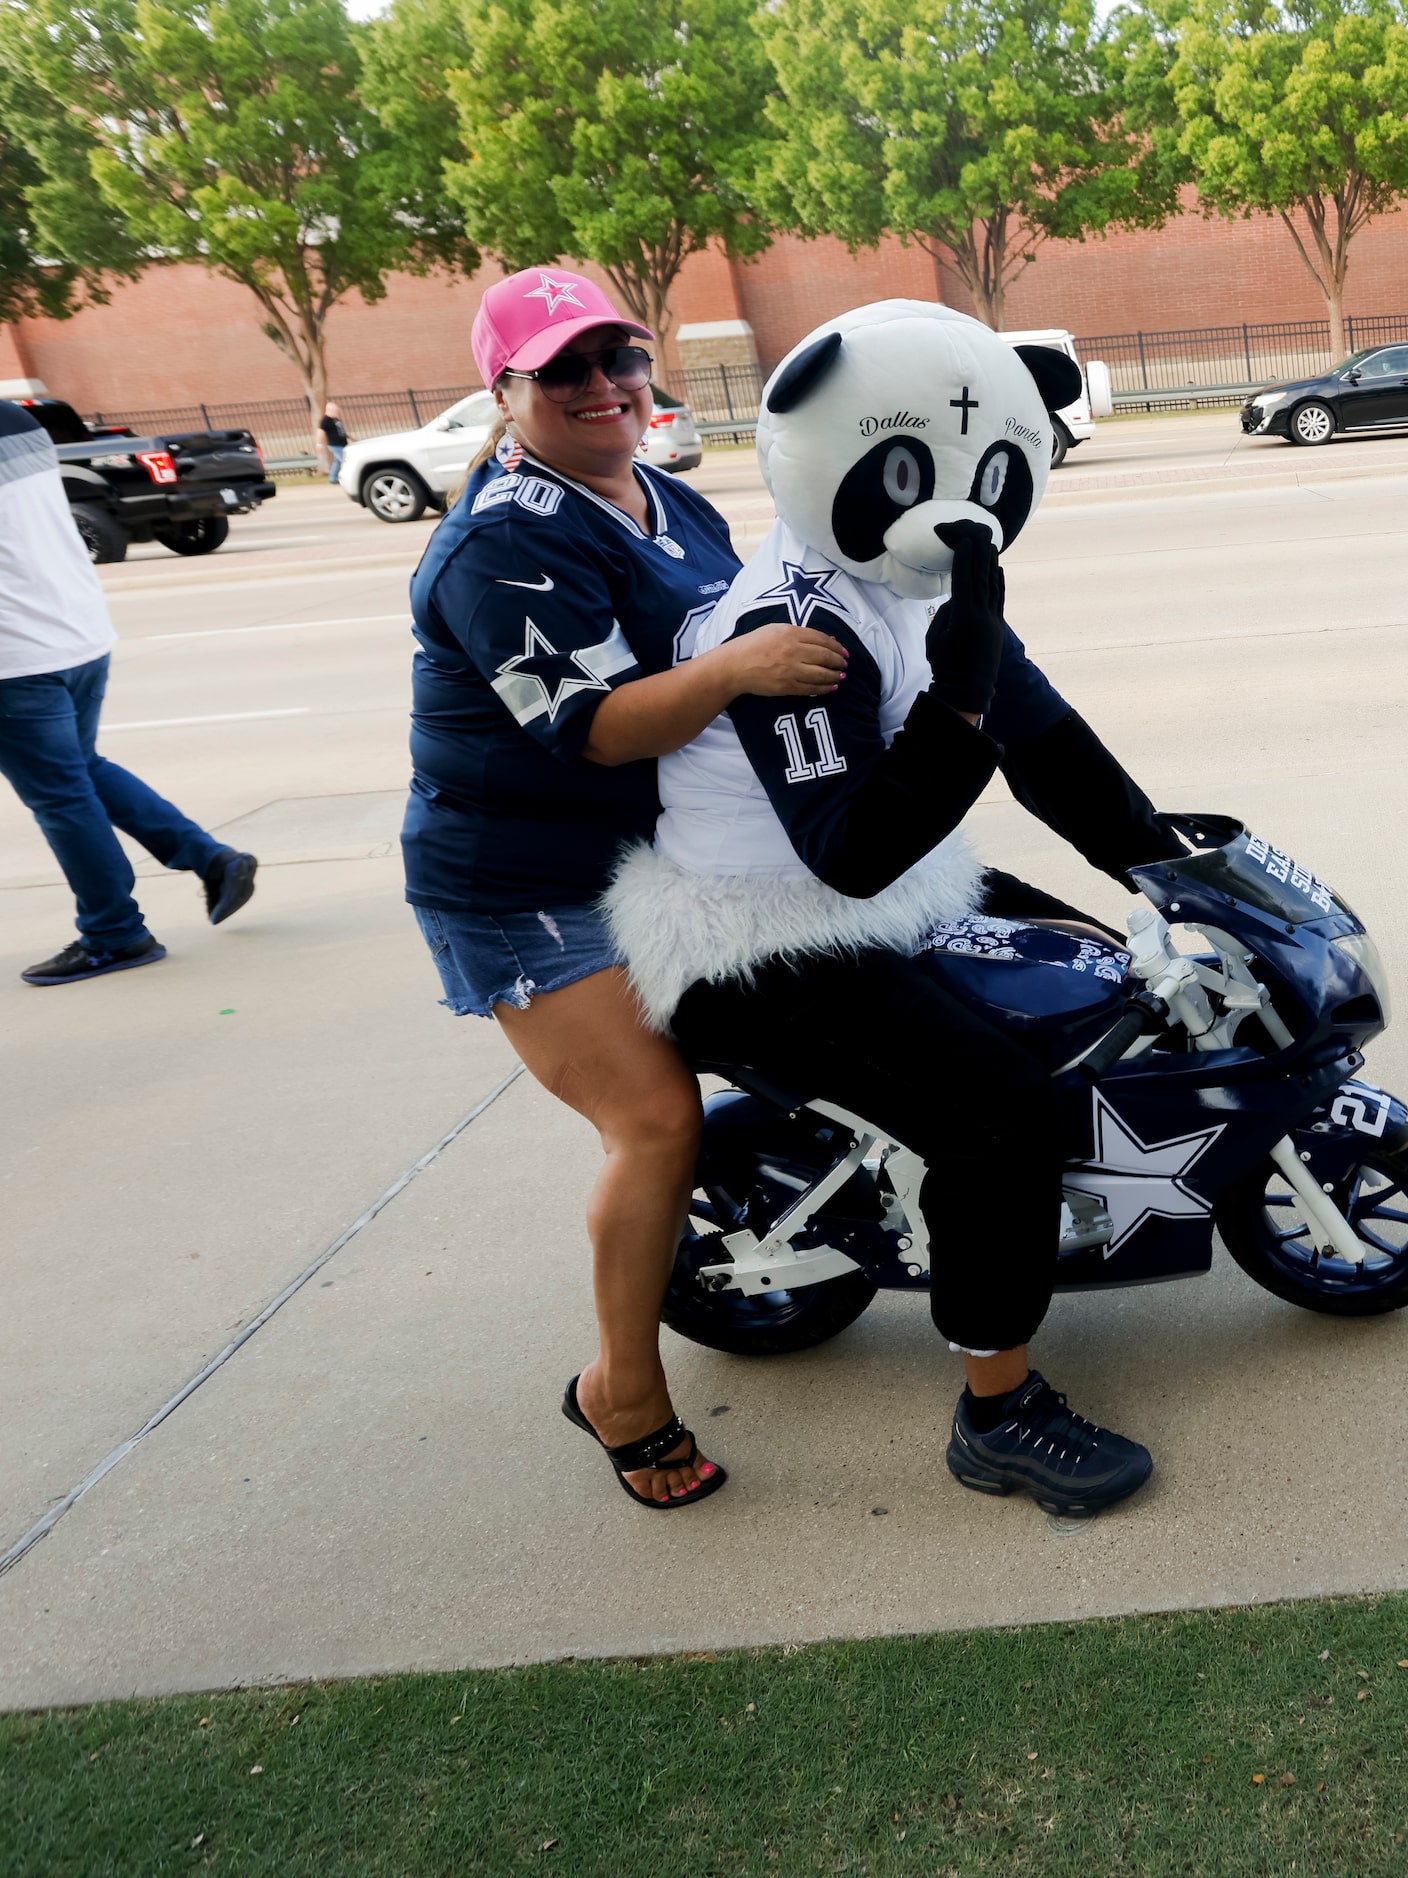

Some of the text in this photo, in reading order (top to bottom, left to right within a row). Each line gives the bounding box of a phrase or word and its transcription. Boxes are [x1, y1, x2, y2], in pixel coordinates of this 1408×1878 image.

[859, 411, 1041, 449] Dallas Panda
[470, 473, 566, 517] 20
[774, 707, 848, 784] 11
[1265, 846, 1292, 884] EAS
[1290, 862, 1313, 894] SID
[1330, 1085, 1392, 1138] 21
